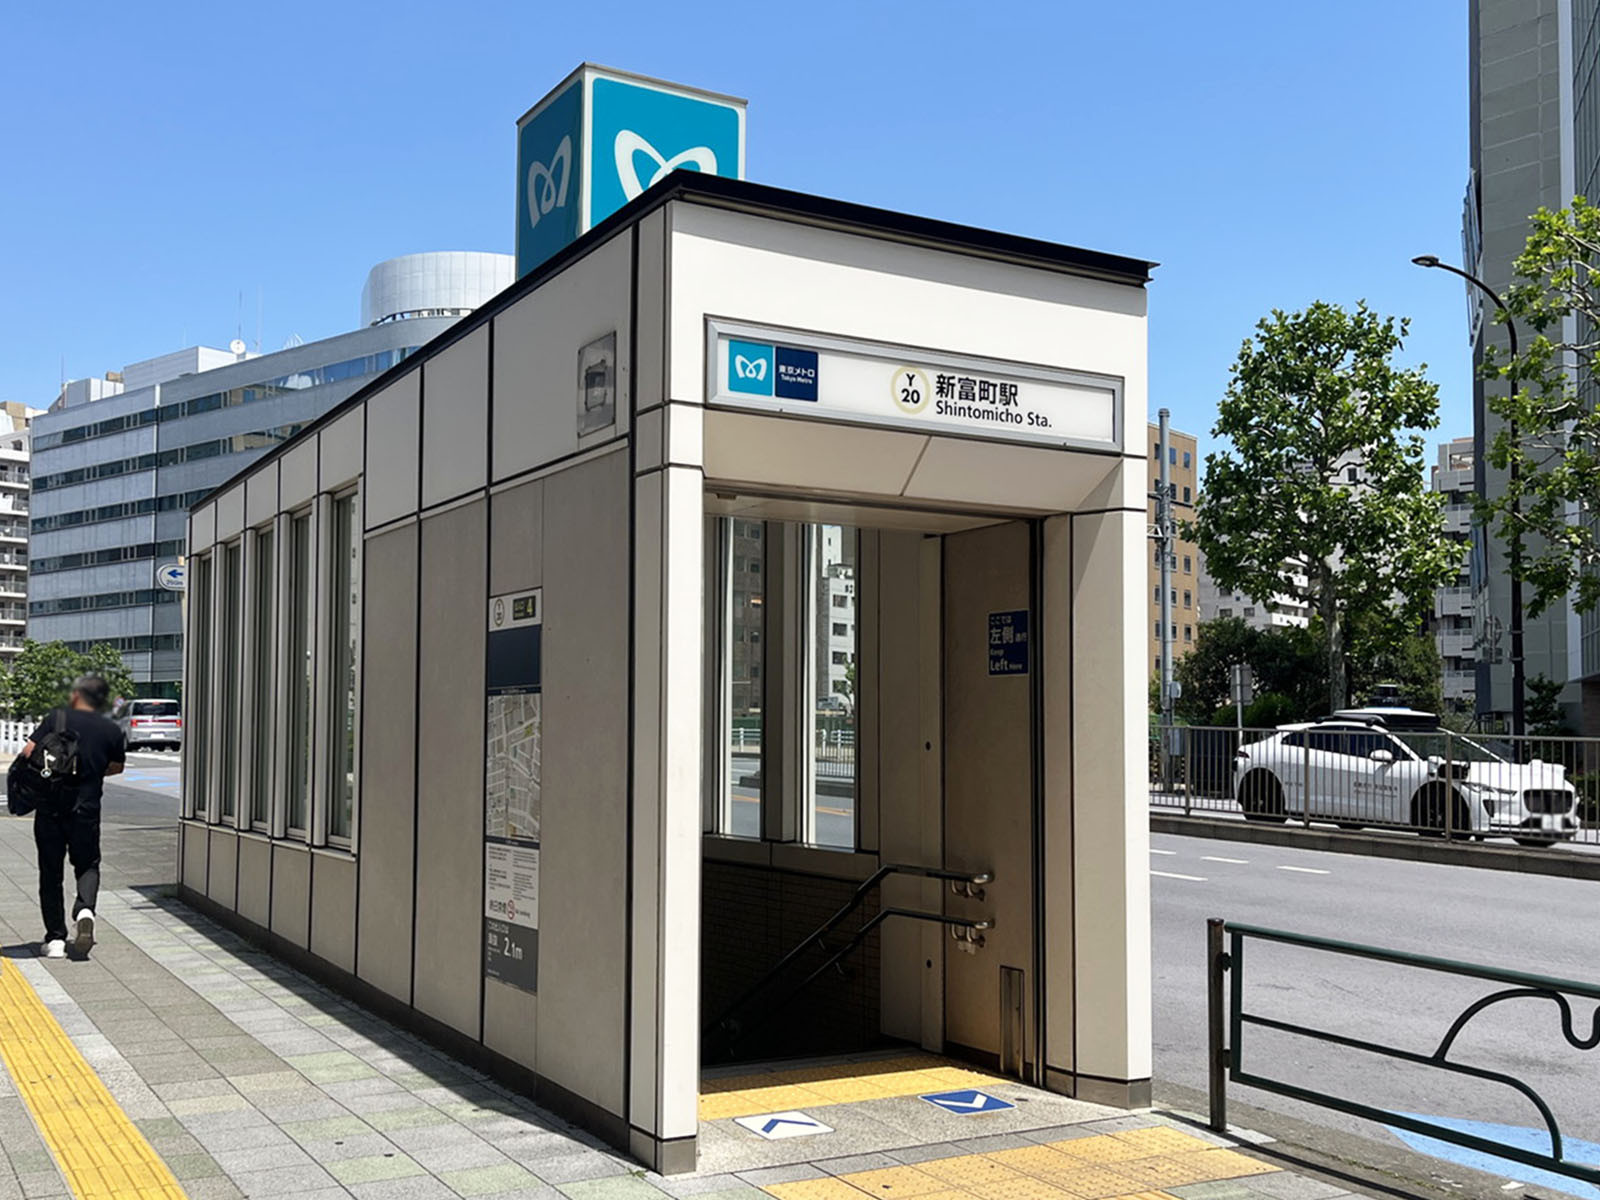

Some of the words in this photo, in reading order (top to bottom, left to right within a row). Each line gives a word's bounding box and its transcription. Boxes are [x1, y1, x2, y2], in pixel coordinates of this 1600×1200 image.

[778, 364, 816, 378] 東京メトロ
[906, 373, 916, 387] Y
[901, 388, 921, 404] 20
[935, 373, 1018, 407] 新富町駅
[935, 400, 1024, 425] Shintomicho
[1027, 411, 1053, 428] Sta.
[526, 598, 534, 616] 4
[990, 658, 1009, 671] Left
